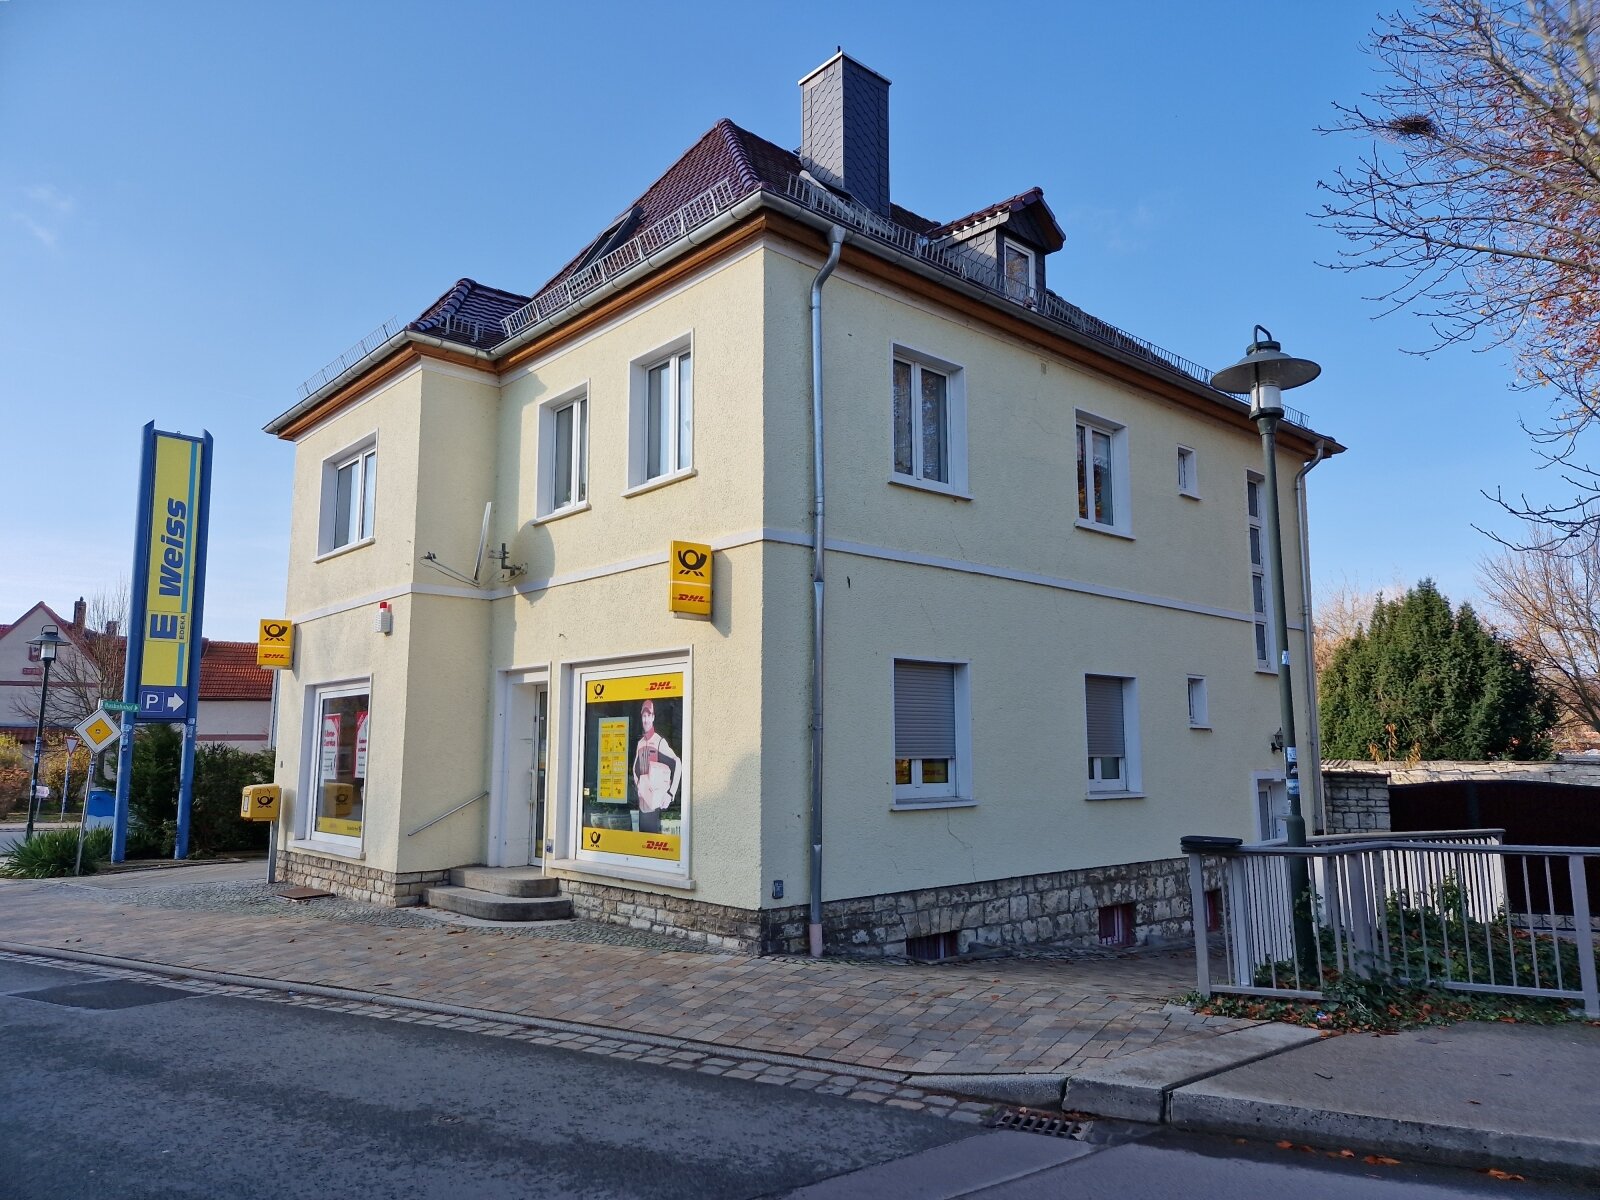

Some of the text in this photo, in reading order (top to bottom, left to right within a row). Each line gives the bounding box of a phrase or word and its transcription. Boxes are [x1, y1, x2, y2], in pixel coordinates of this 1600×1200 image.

[150, 497, 187, 640] E Weiss
[678, 593, 706, 603] DHL
[649, 680, 672, 691] DHL
[145, 694, 159, 709] P
[646, 840, 669, 851] DHL
